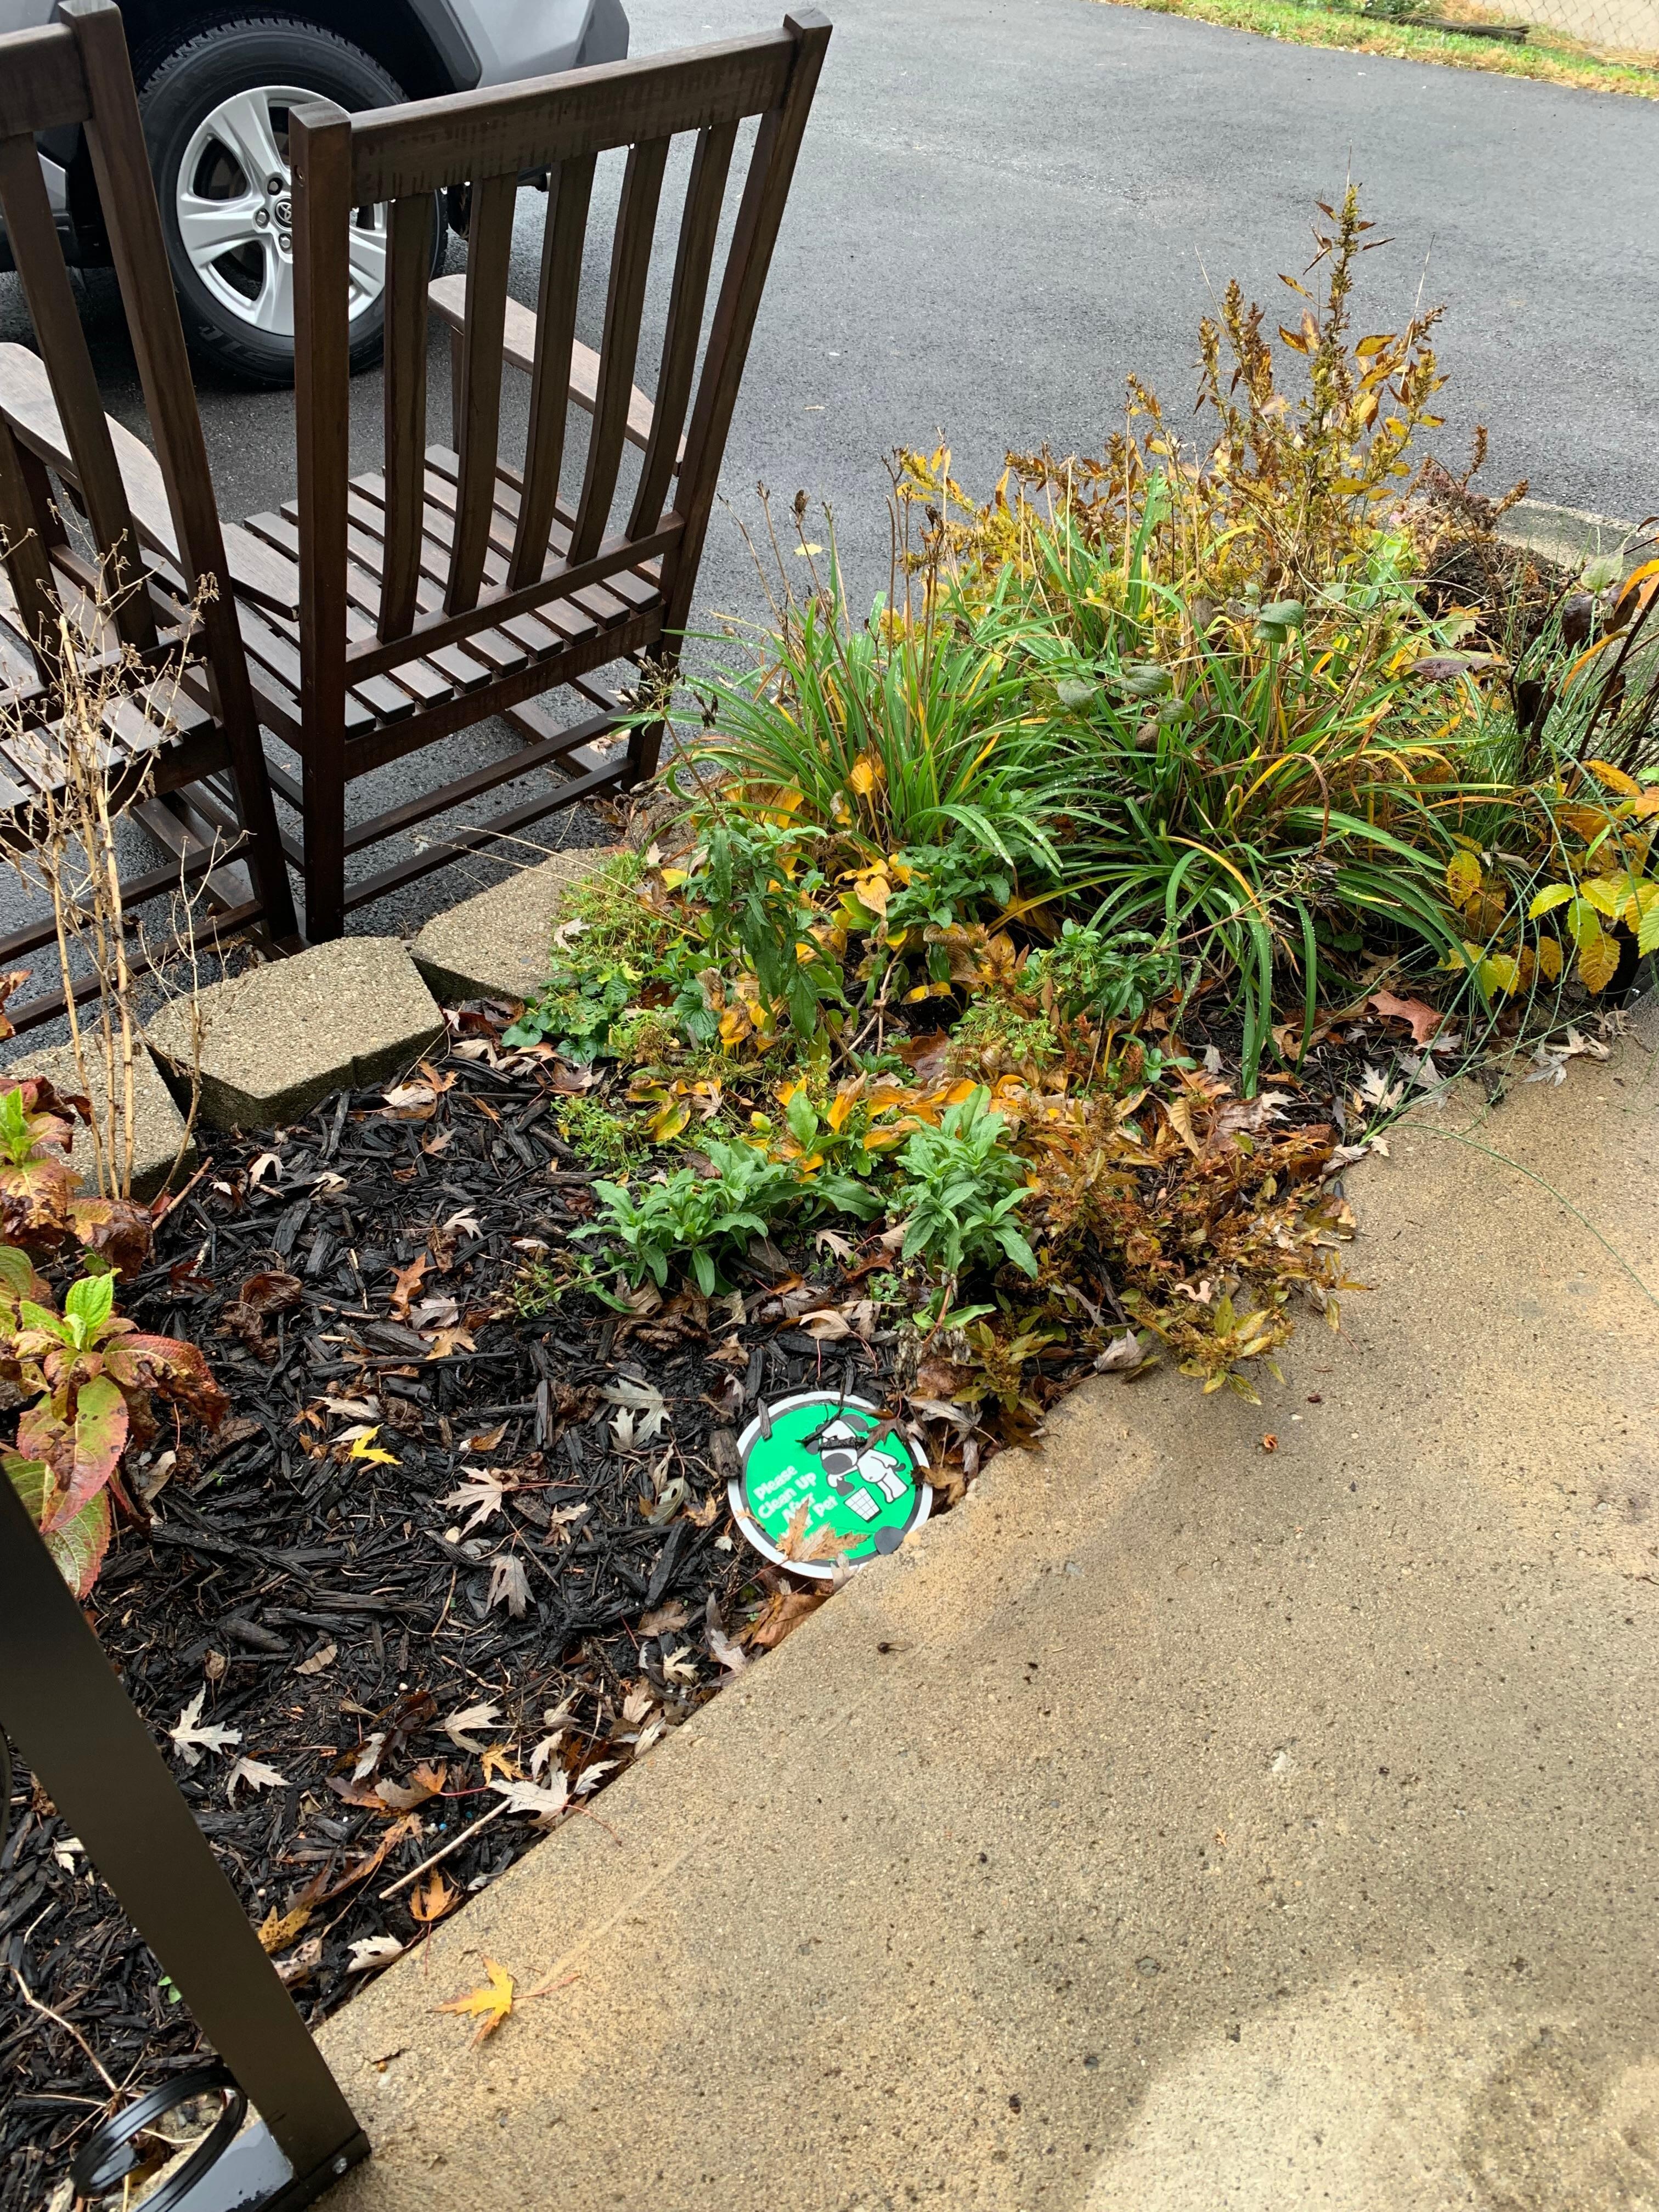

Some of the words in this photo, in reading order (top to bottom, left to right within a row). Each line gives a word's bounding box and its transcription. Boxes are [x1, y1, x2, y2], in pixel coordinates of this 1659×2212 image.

[753, 1465, 798, 1500] Please
[758, 1488, 797, 1519] Clean
[795, 1472, 816, 1489] Up
[812, 1496, 838, 1517] Pet
